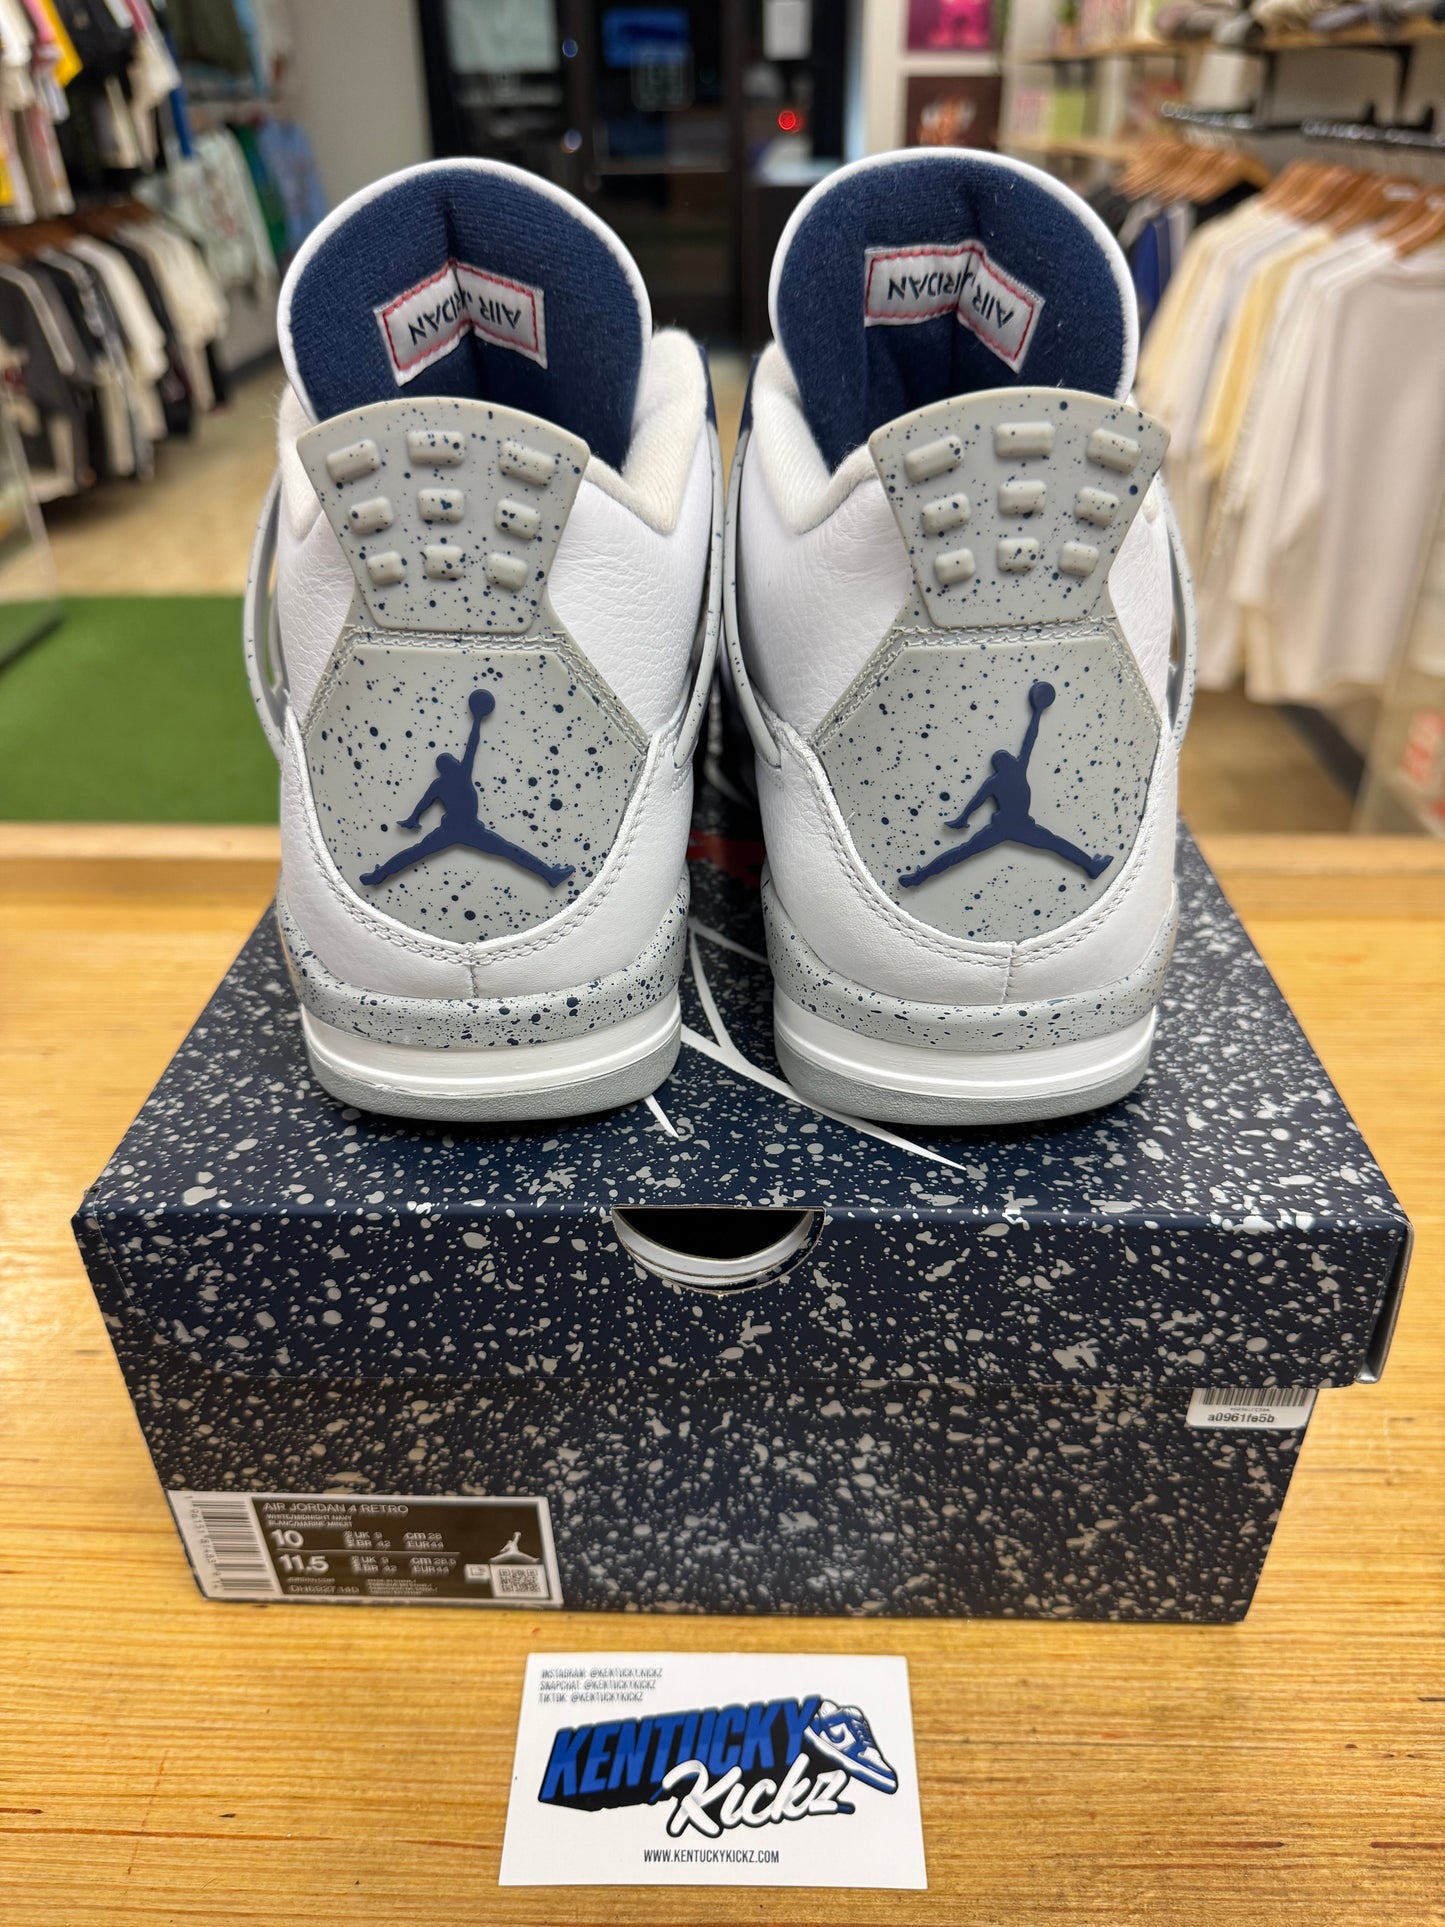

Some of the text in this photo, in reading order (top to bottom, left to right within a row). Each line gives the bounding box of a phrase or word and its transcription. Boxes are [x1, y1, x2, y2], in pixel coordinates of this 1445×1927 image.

[971, 282, 1015, 330] AIR
[478, 296, 522, 330] AIR
[1207, 1412, 1275, 1423] a0961fe5b
[264, 1502, 409, 1514] AIR JORDAN 4 RETRO
[271, 1529, 304, 1548] 10
[354, 1531, 370, 1539] UK
[357, 1540, 391, 1548] BR 42
[279, 1554, 329, 1572] 11.5
[361, 1556, 376, 1564] UK
[540, 1680, 582, 1690] SNAPCHAT:
[541, 1696, 821, 1801] KENTUCKY
[643, 1848, 780, 1863] WWW.KENTUCKYKICKZ.COM
